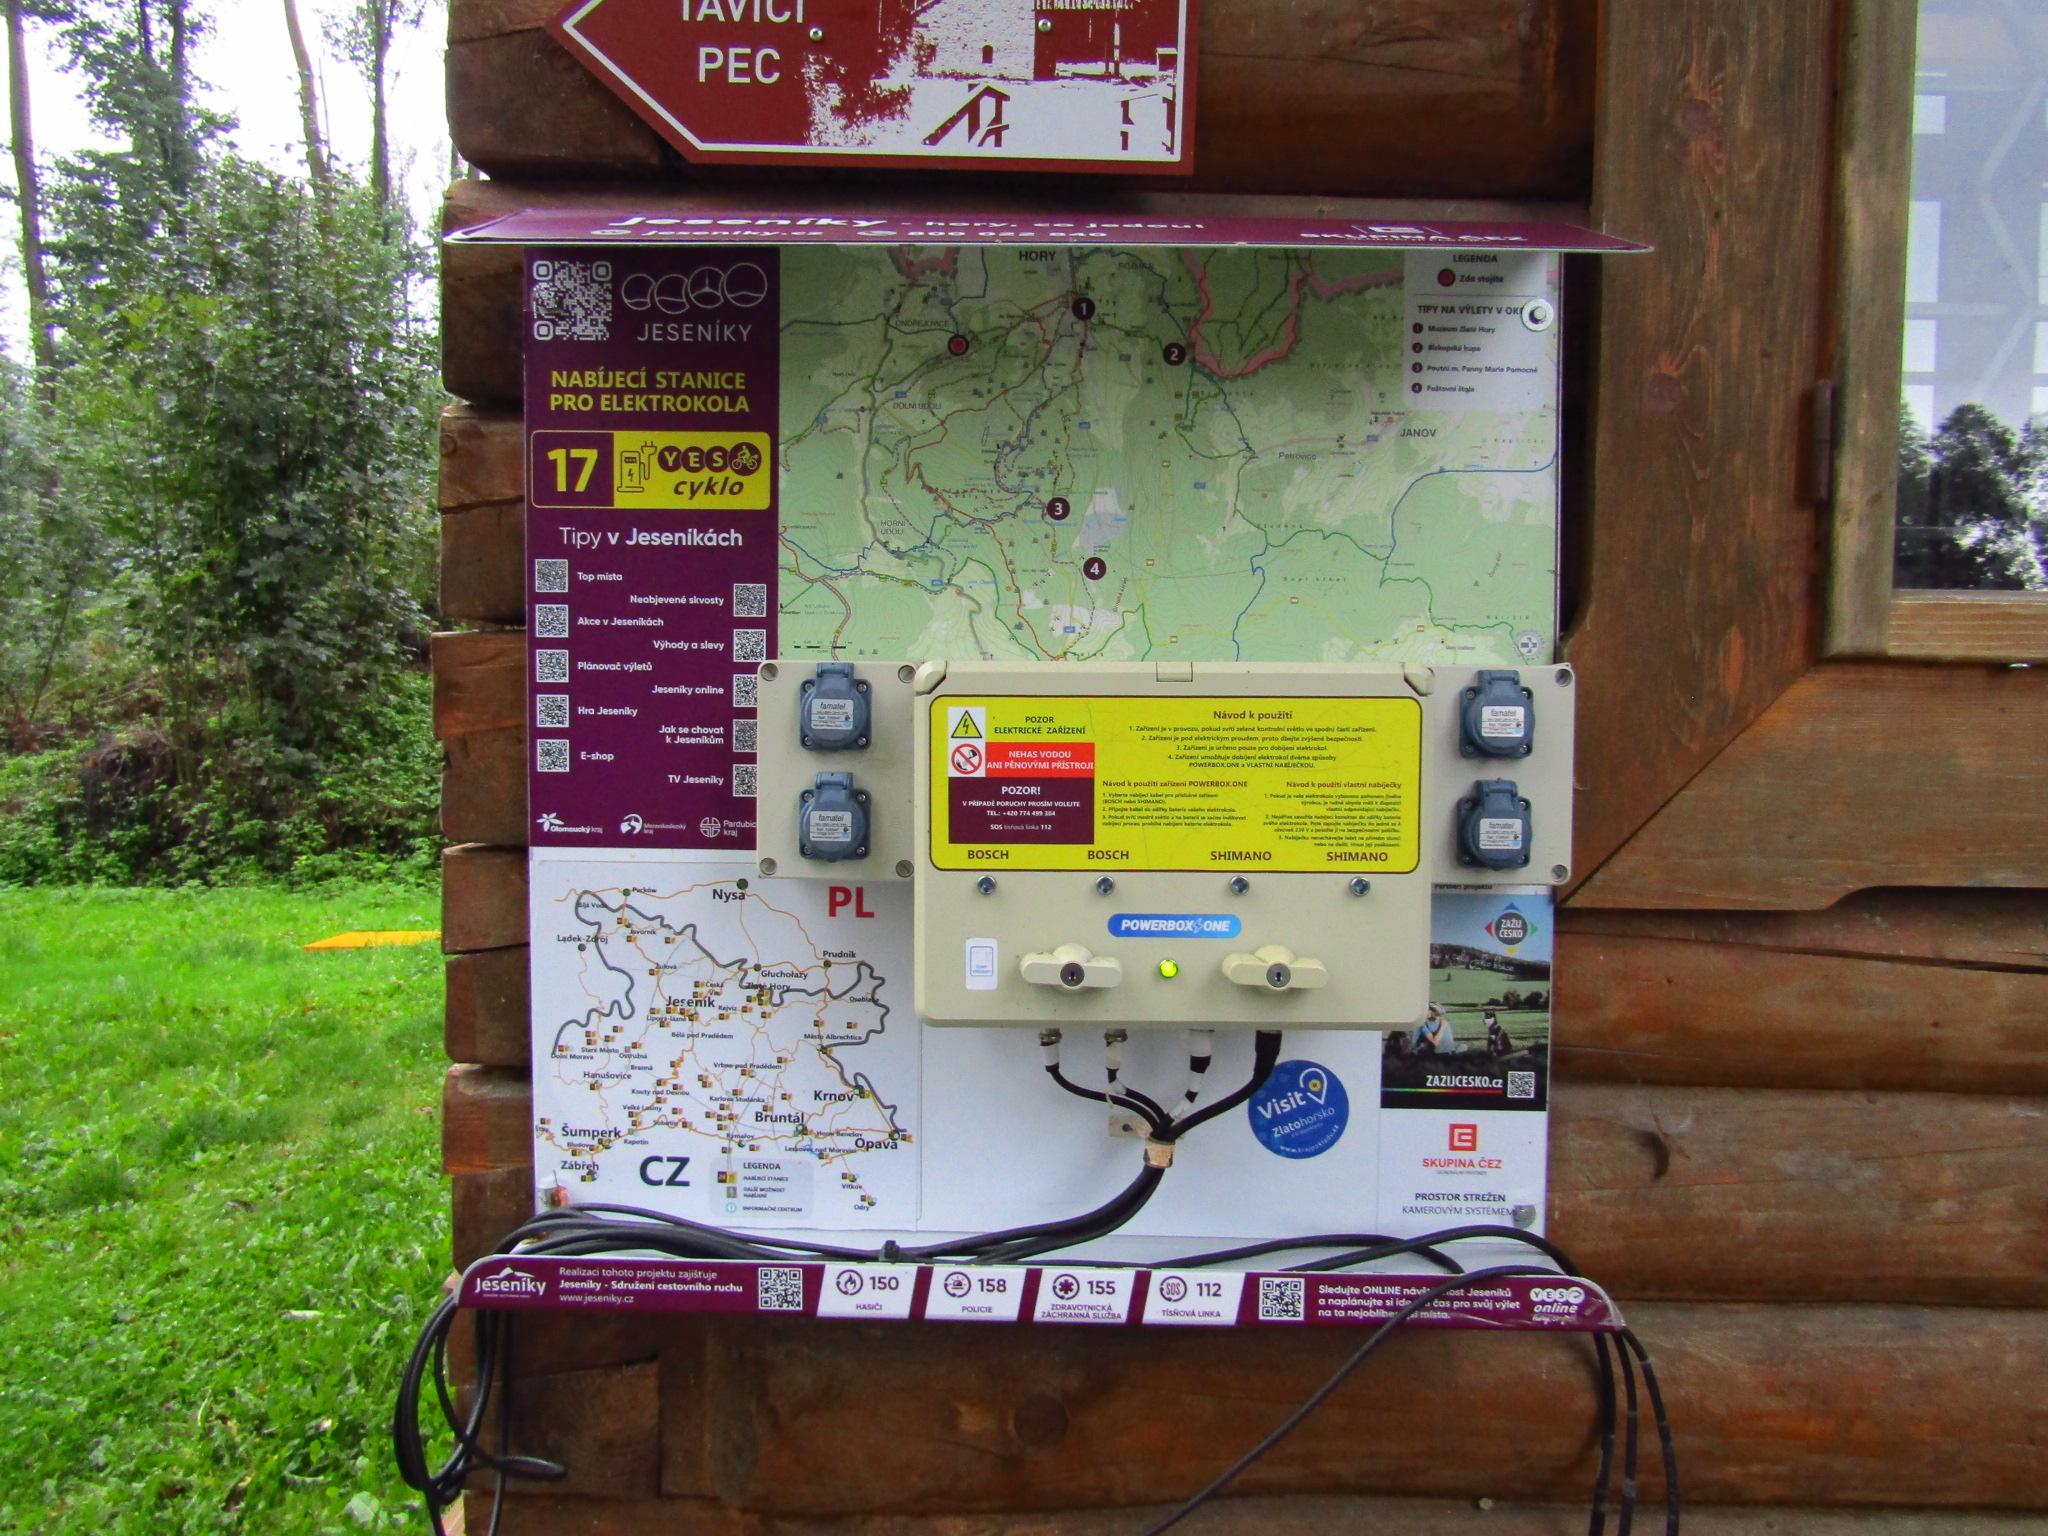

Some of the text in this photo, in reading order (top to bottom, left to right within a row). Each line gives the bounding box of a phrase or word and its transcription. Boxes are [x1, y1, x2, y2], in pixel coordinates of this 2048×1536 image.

[699, 47, 780, 84] PEC
[1018, 250, 1057, 261] HORY
[1453, 254, 1498, 263] LEGENDA
[1441, 306, 1455, 314] NA
[1459, 303, 1493, 315] VÝLETY
[1495, 306, 1503, 315] V
[637, 320, 752, 342] JESENÍKY
[551, 366, 747, 390] NABÍJECÍ STANICE
[550, 394, 750, 413] PRO ELEKTROKOLA
[1400, 428, 1437, 438] JANOV
[662, 450, 726, 468] YES
[547, 448, 599, 493] 17
[673, 476, 745, 500] cyklo
[559, 527, 743, 549] Tipy v Jeseníkách
[577, 572, 623, 583] Top místa
[630, 594, 725, 607] Neobjevené skvosty
[577, 617, 602, 627] Akce
[610, 616, 664, 627] Jeseníkách
[653, 639, 725, 651] Výhody a slevy
[577, 661, 653, 673] Plánovač výletů
[651, 684, 725, 696] Jeseníky online
[577, 706, 638, 717] Hra Jeseníky
[1213, 710, 1246, 719] Návod
[1257, 710, 1293, 721] použití
[1025, 716, 1055, 724] POZOR
[658, 725, 724, 734] Jak se chovat
[994, 726, 1086, 735] ELEKTRICKÉ ZAŘÍZENÍ
[673, 734, 724, 744] Jeseníkům
[580, 752, 614, 762] E-shop
[1008, 750, 1072, 758] NEHAS VODOU
[986, 760, 1094, 770] ANI PĚNOVÝMI PŘÍSTROJI
[668, 775, 724, 786] TV Jeseníky
[1102, 780, 1126, 788] Návod
[1001, 786, 1041, 795] POZOR!
[723, 819, 756, 828] Pardubic
[550, 825, 603, 836] Olomoucký kraj
[723, 829, 738, 838] kraj
[967, 850, 1388, 862] BOSCH BOSCH SHIMANO SHIMANO
[712, 889, 746, 903] Nysa
[828, 885, 875, 918] PL
[1121, 919, 1230, 932] POWERBOX ONE
[1499, 928, 1523, 938] ČESKO
[822, 950, 856, 959] Prudnik
[761, 969, 808, 980] Głuchołazy
[769, 983, 791, 992] Hory
[665, 995, 715, 1008] Jeseník
[687, 1032, 699, 1040] pod
[583, 1070, 632, 1080] Hanušovice
[1426, 1074, 1503, 1088] ZAZIJCESKO.cz
[814, 1090, 854, 1102] Krnov
[1257, 1091, 1307, 1119] Visit
[755, 1111, 804, 1123] Bruntál
[1271, 1106, 1335, 1138] Zlatohorsko
[561, 1122, 621, 1139] Šumperk
[855, 1138, 898, 1151] Opava
[560, 1160, 600, 1171] Zábřeh
[743, 1162, 781, 1170] LEGENDA
[1422, 1157, 1503, 1169] SKUPINA ČEZ
[639, 1155, 691, 1187] CZ
[1415, 1192, 1461, 1202] PROSTOR
[854, 1204, 870, 1212] Odry
[1402, 1204, 1464, 1217] KAMEROVÝM
[559, 1266, 718, 1282] Realizaci tohoto projektu zajišťuje
[474, 1276, 546, 1296] Jeseníky
[559, 1279, 743, 1293] Jeseníky Sdružení cestovního ruchu
[869, 1275, 899, 1290] 150
[978, 1278, 1007, 1293] 158
[1087, 1280, 1116, 1295] 155
[1163, 1283, 1182, 1296] SOS
[1196, 1282, 1222, 1297] 112
[1318, 1284, 1512, 1298] Sledujte ONLINE Jeseníků
[1533, 1290, 1565, 1299] YES
[559, 1294, 635, 1305] www.jeseniky.cz
[1328, 1297, 1383, 1308] naplánujte
[1385, 1298, 1393, 1306] si
[1433, 1299, 1450, 1308] čas
[1453, 1301, 1471, 1310] pro
[1473, 1299, 1493, 1311] svůj
[1495, 1299, 1520, 1311] výlet
[856, 1302, 883, 1311] HASIČI
[961, 1305, 993, 1314] POLICIE
[1050, 1303, 1113, 1312] ZDRAVOTNICKÁ
[1161, 1307, 1221, 1318] TÍSŇOVÁ LINKA
[1318, 1309, 1332, 1317] na
[1334, 1308, 1344, 1317] ta
[1533, 1302, 1579, 1314] online
[1041, 1309, 1122, 1320] ZÁCHRANNÁ SLUŽBA
